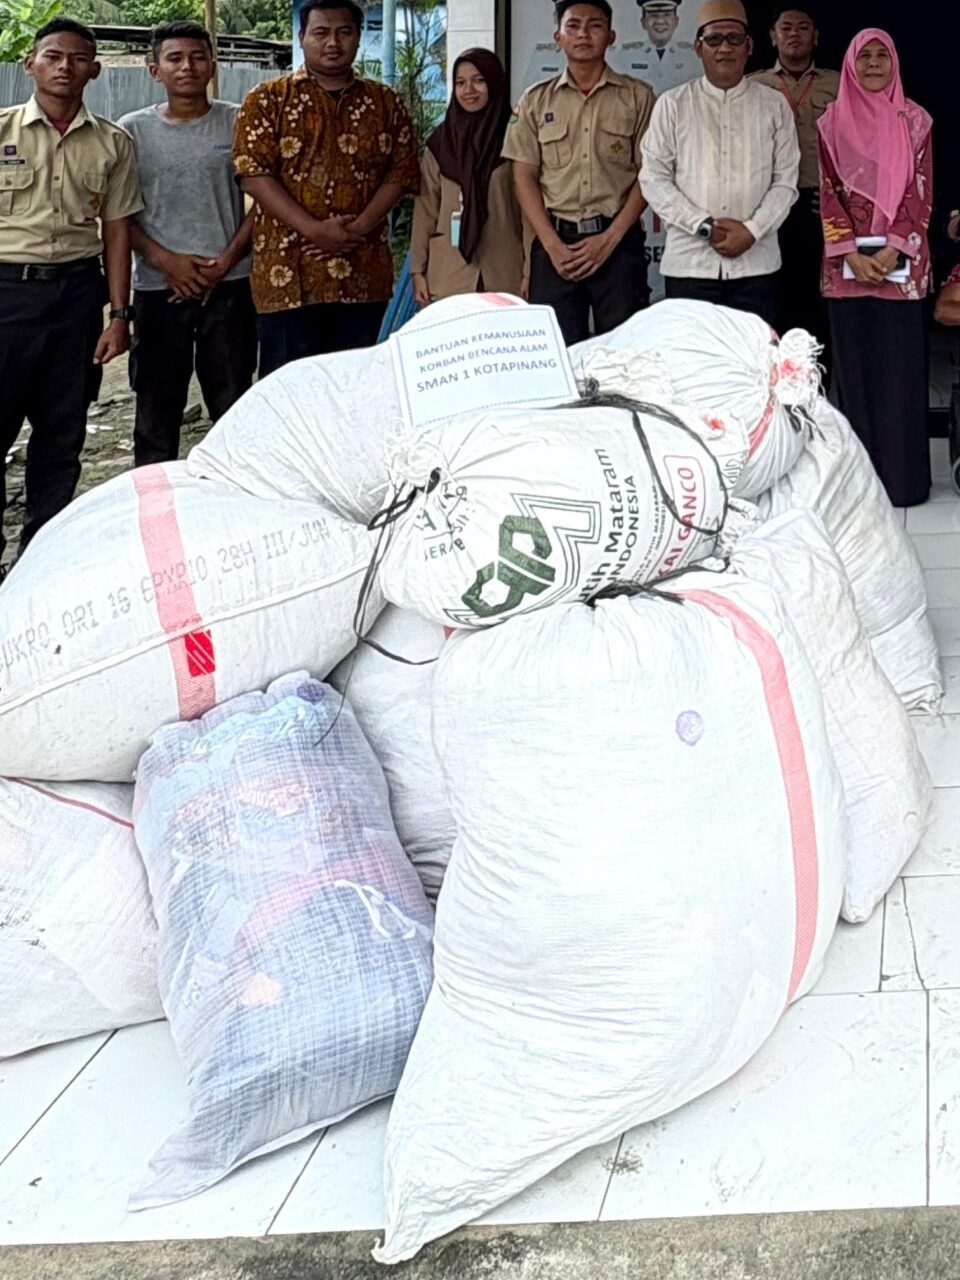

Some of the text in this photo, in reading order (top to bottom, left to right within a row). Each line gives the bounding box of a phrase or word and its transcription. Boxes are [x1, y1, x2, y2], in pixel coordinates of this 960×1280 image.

[415, 328, 547, 358] BANTUAN KEMANUSIAAN
[419, 343, 549, 373] KORBAN BENCANA ALAM
[416, 358, 557, 393] SMAN 1 KOTAPINANG
[594, 449, 624, 553] Mataram
[607, 475, 639, 582] INDONESIA
